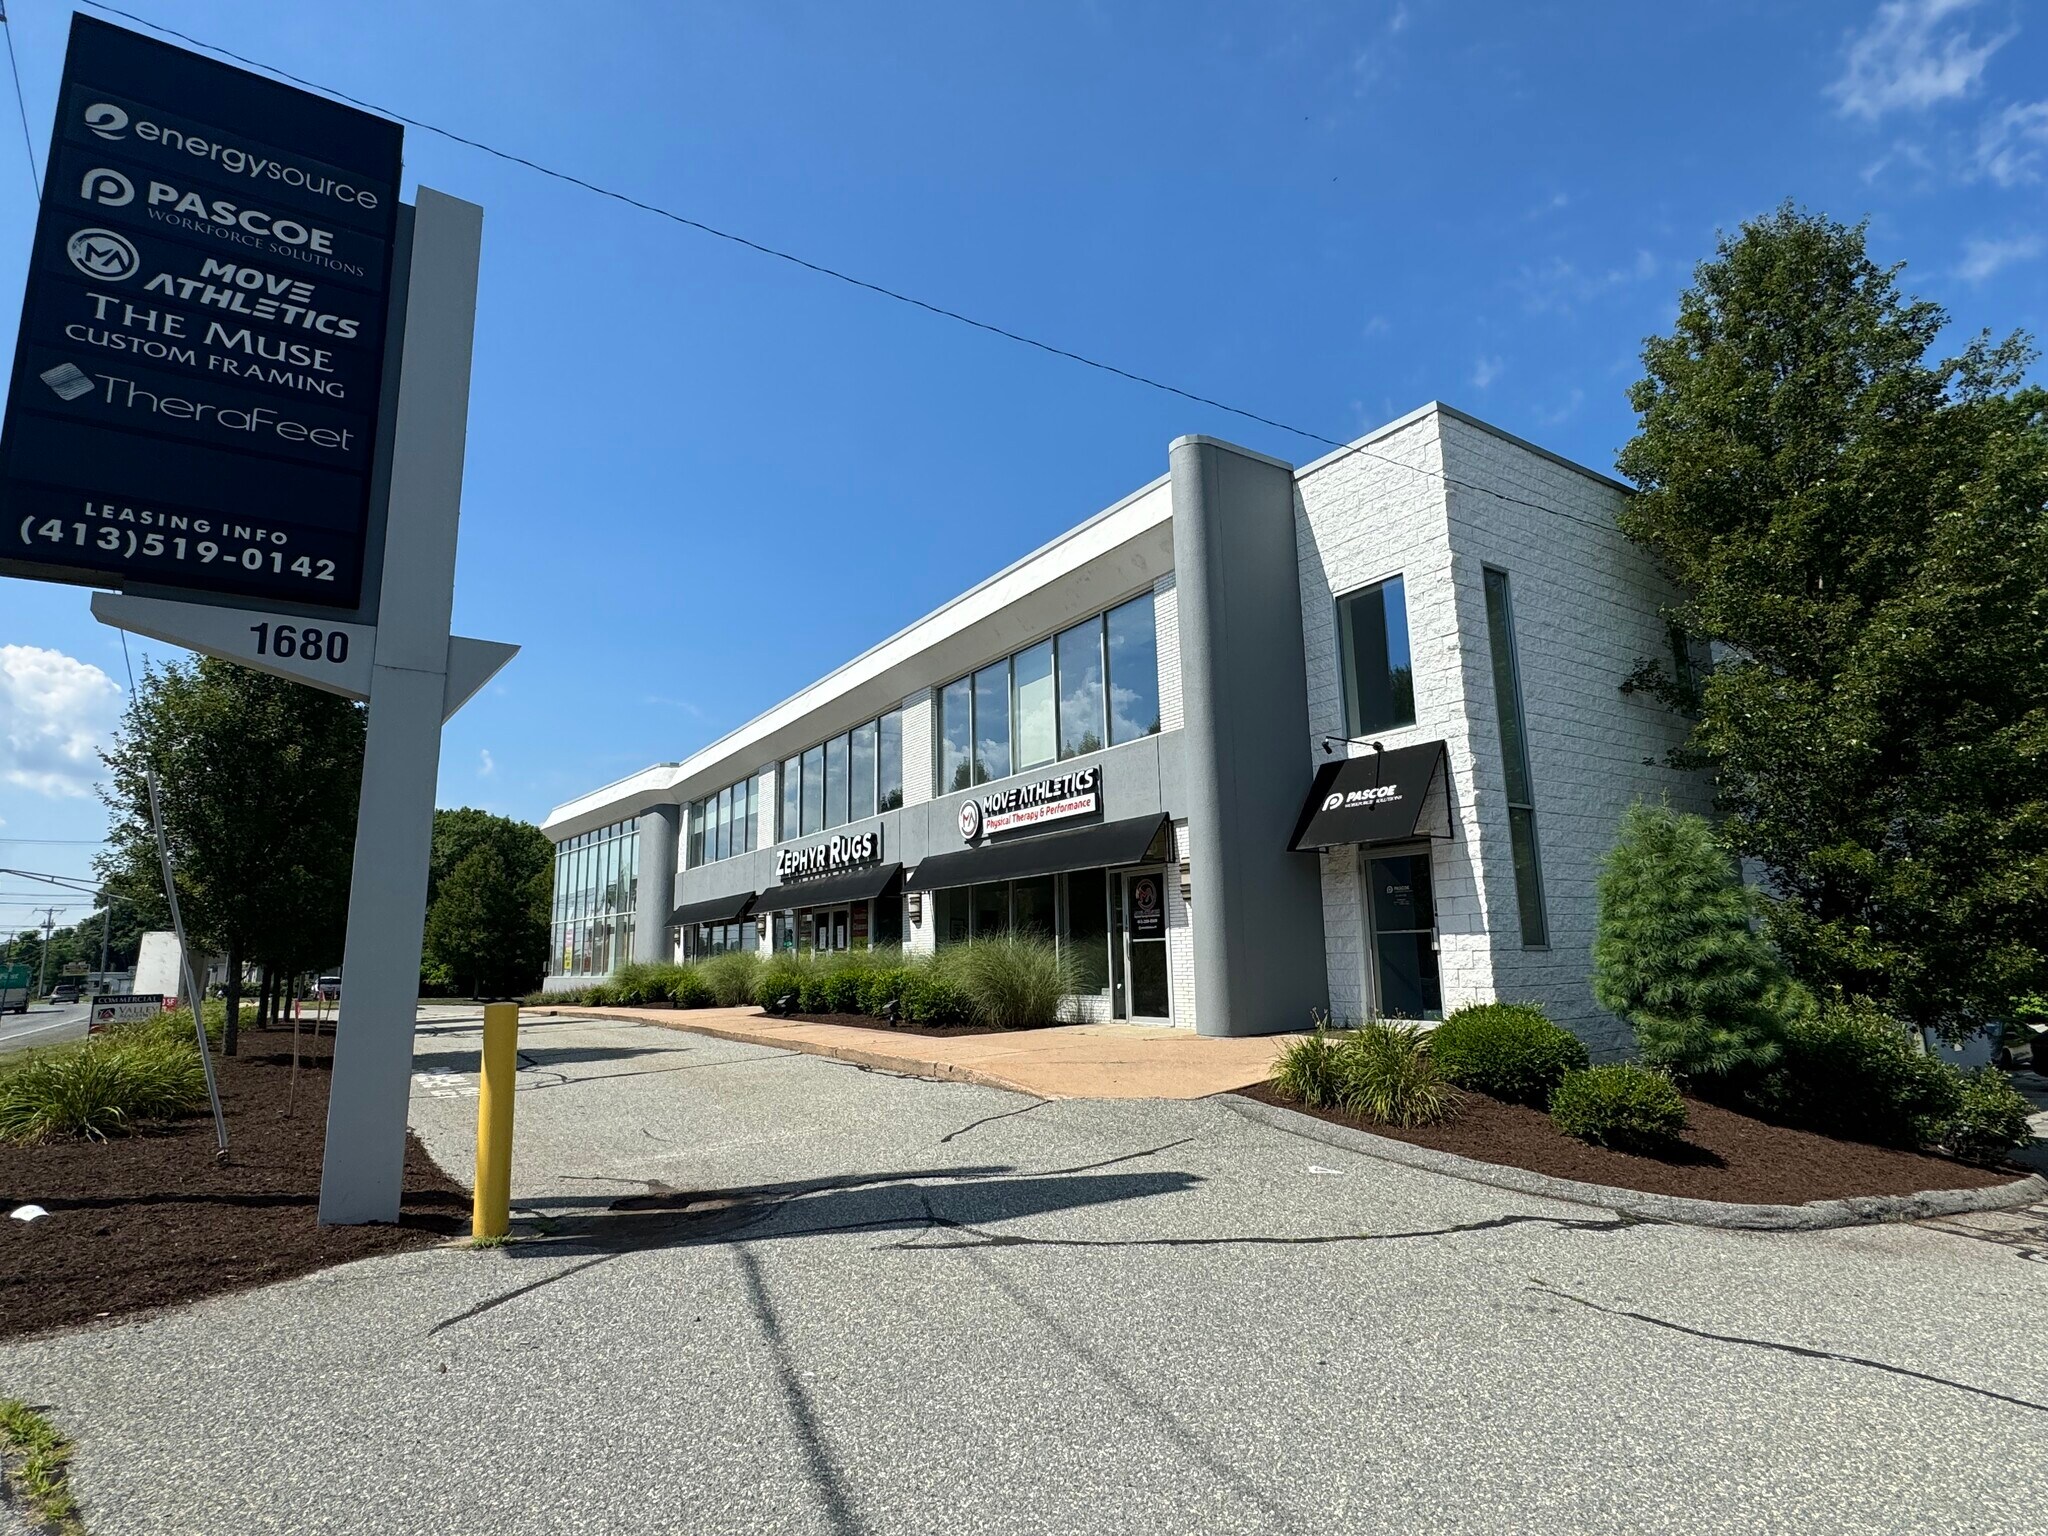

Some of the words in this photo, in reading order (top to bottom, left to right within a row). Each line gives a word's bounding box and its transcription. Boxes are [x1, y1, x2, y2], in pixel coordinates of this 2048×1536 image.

[135, 118, 378, 210] energysource
[148, 181, 334, 256] PASCOE
[148, 208, 264, 250] WORKFORCE
[269, 242, 365, 278] SOLUTIONS
[144, 273, 361, 339] ATHLETICS
[200, 258, 315, 304] MOVE
[86, 292, 188, 339] THE
[203, 322, 335, 373] MUSE
[65, 324, 197, 367] CUSTOM
[209, 355, 345, 399] FRAMING
[95, 373, 354, 451] TheraFeet
[20, 515, 336, 581] (413)519-0142
[85, 502, 211, 534] LEASING
[222, 523, 288, 545] INFO
[250, 621, 349, 664] 1680
[983, 789, 1017, 813] MOVE
[1018, 768, 1094, 805] ATHLETICS
[986, 817, 1011, 830] Physical
[1012, 810, 1039, 824] Therapy
[1040, 808, 1045, 817] &
[1045, 798, 1092, 817] Performance
[1346, 784, 1397, 803] PASCOE
[775, 844, 826, 877] ZEPHYR
[829, 832, 872, 866] RUGS
[98, 995, 158, 1004] COMMERCIAL
